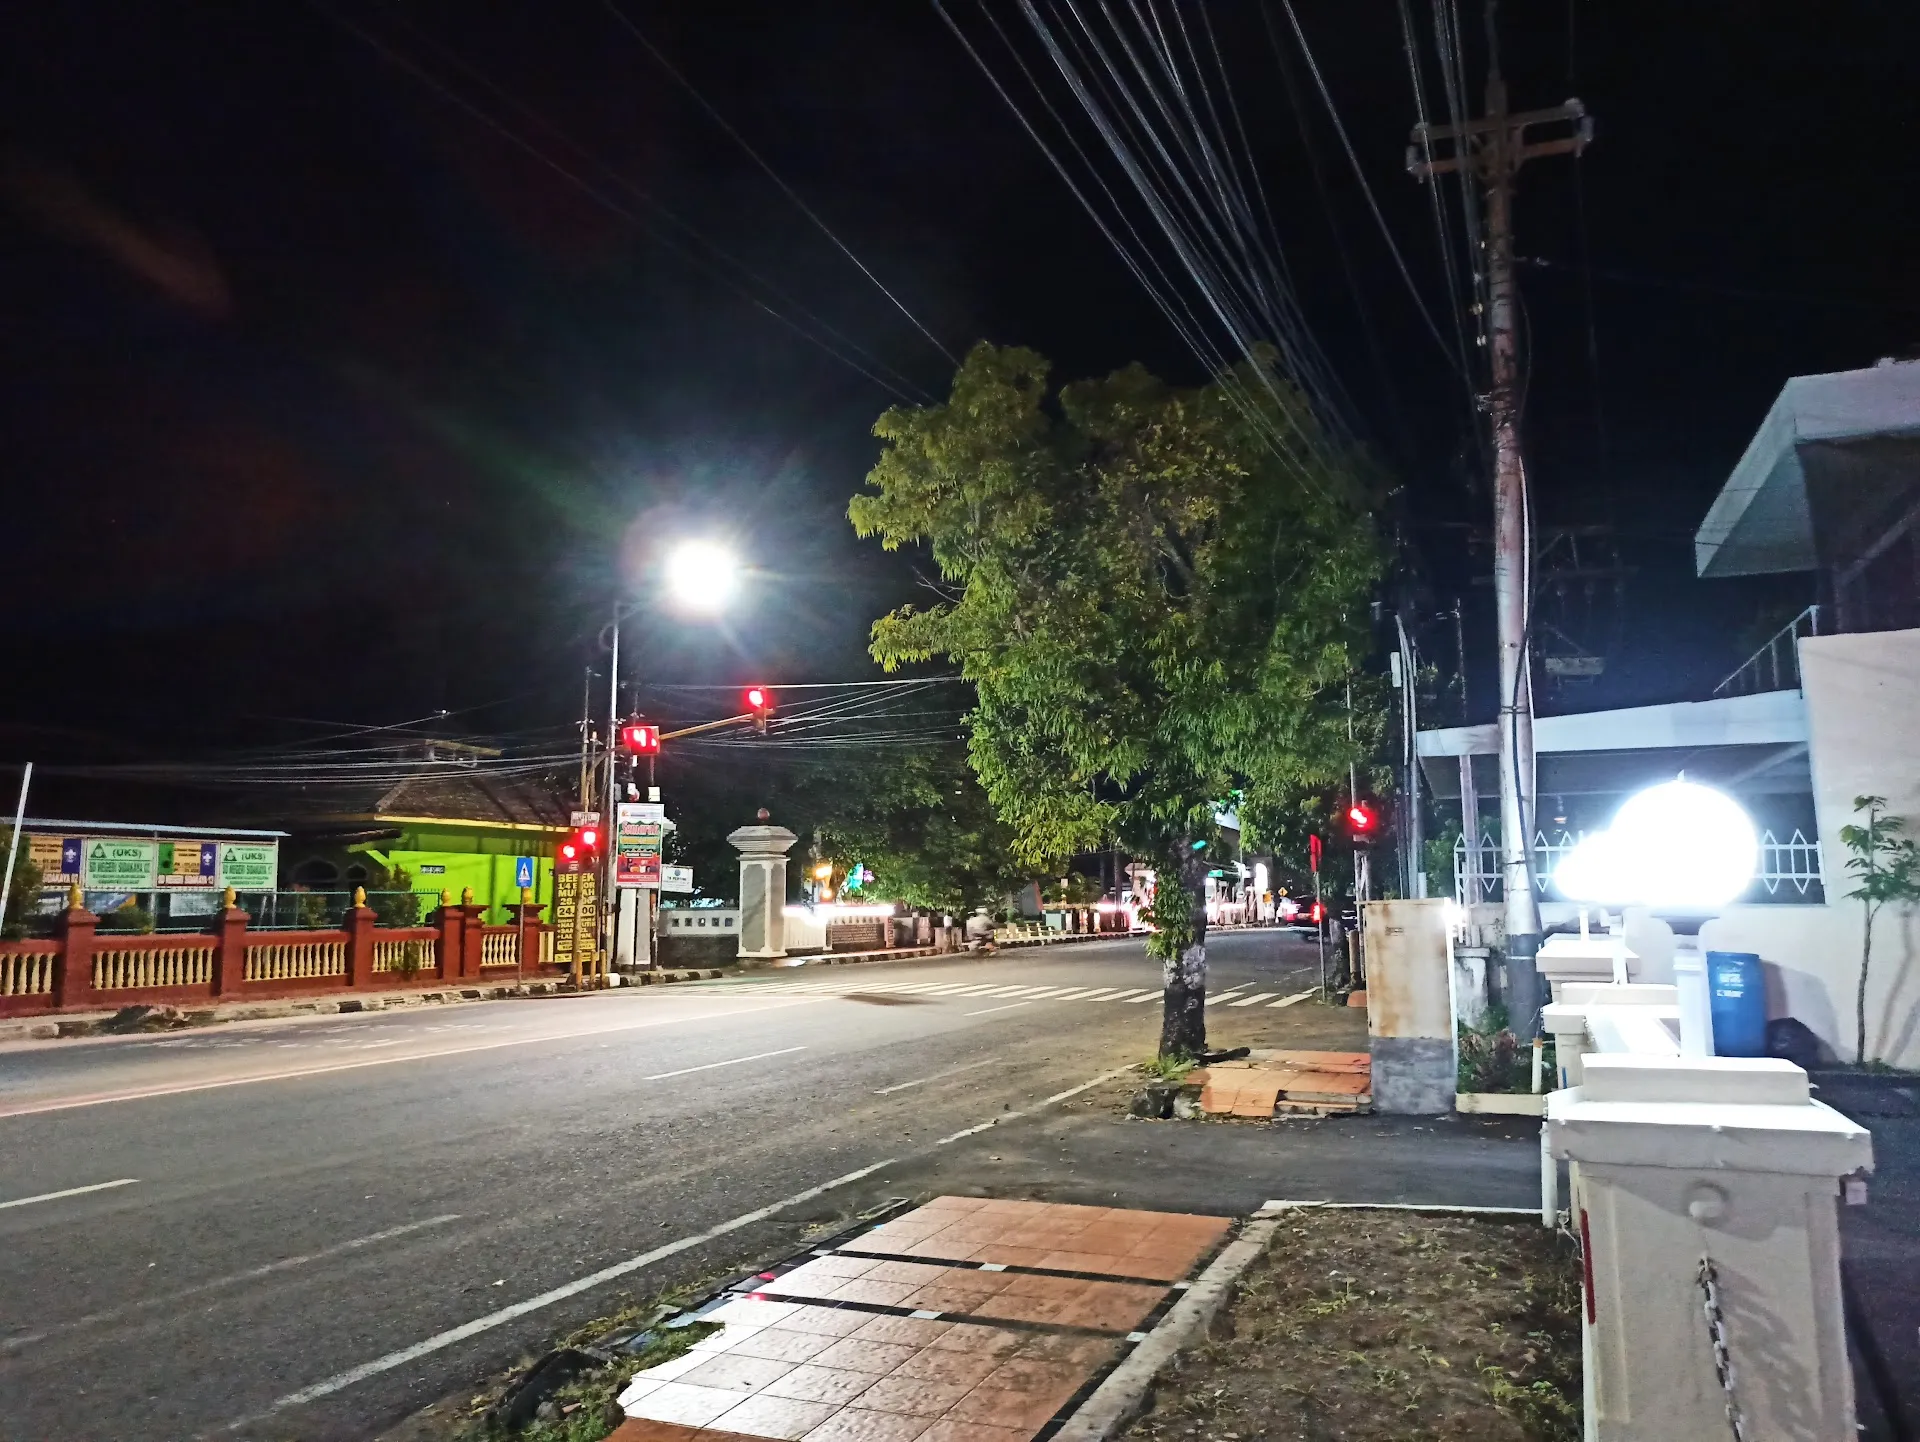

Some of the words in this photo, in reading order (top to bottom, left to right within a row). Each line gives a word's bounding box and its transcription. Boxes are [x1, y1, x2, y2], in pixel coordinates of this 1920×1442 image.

[558, 872, 595, 883] BEBEK
[573, 881, 595, 889] EOR
[558, 888, 595, 898] MUAH
[559, 906, 594, 916] 24.00
